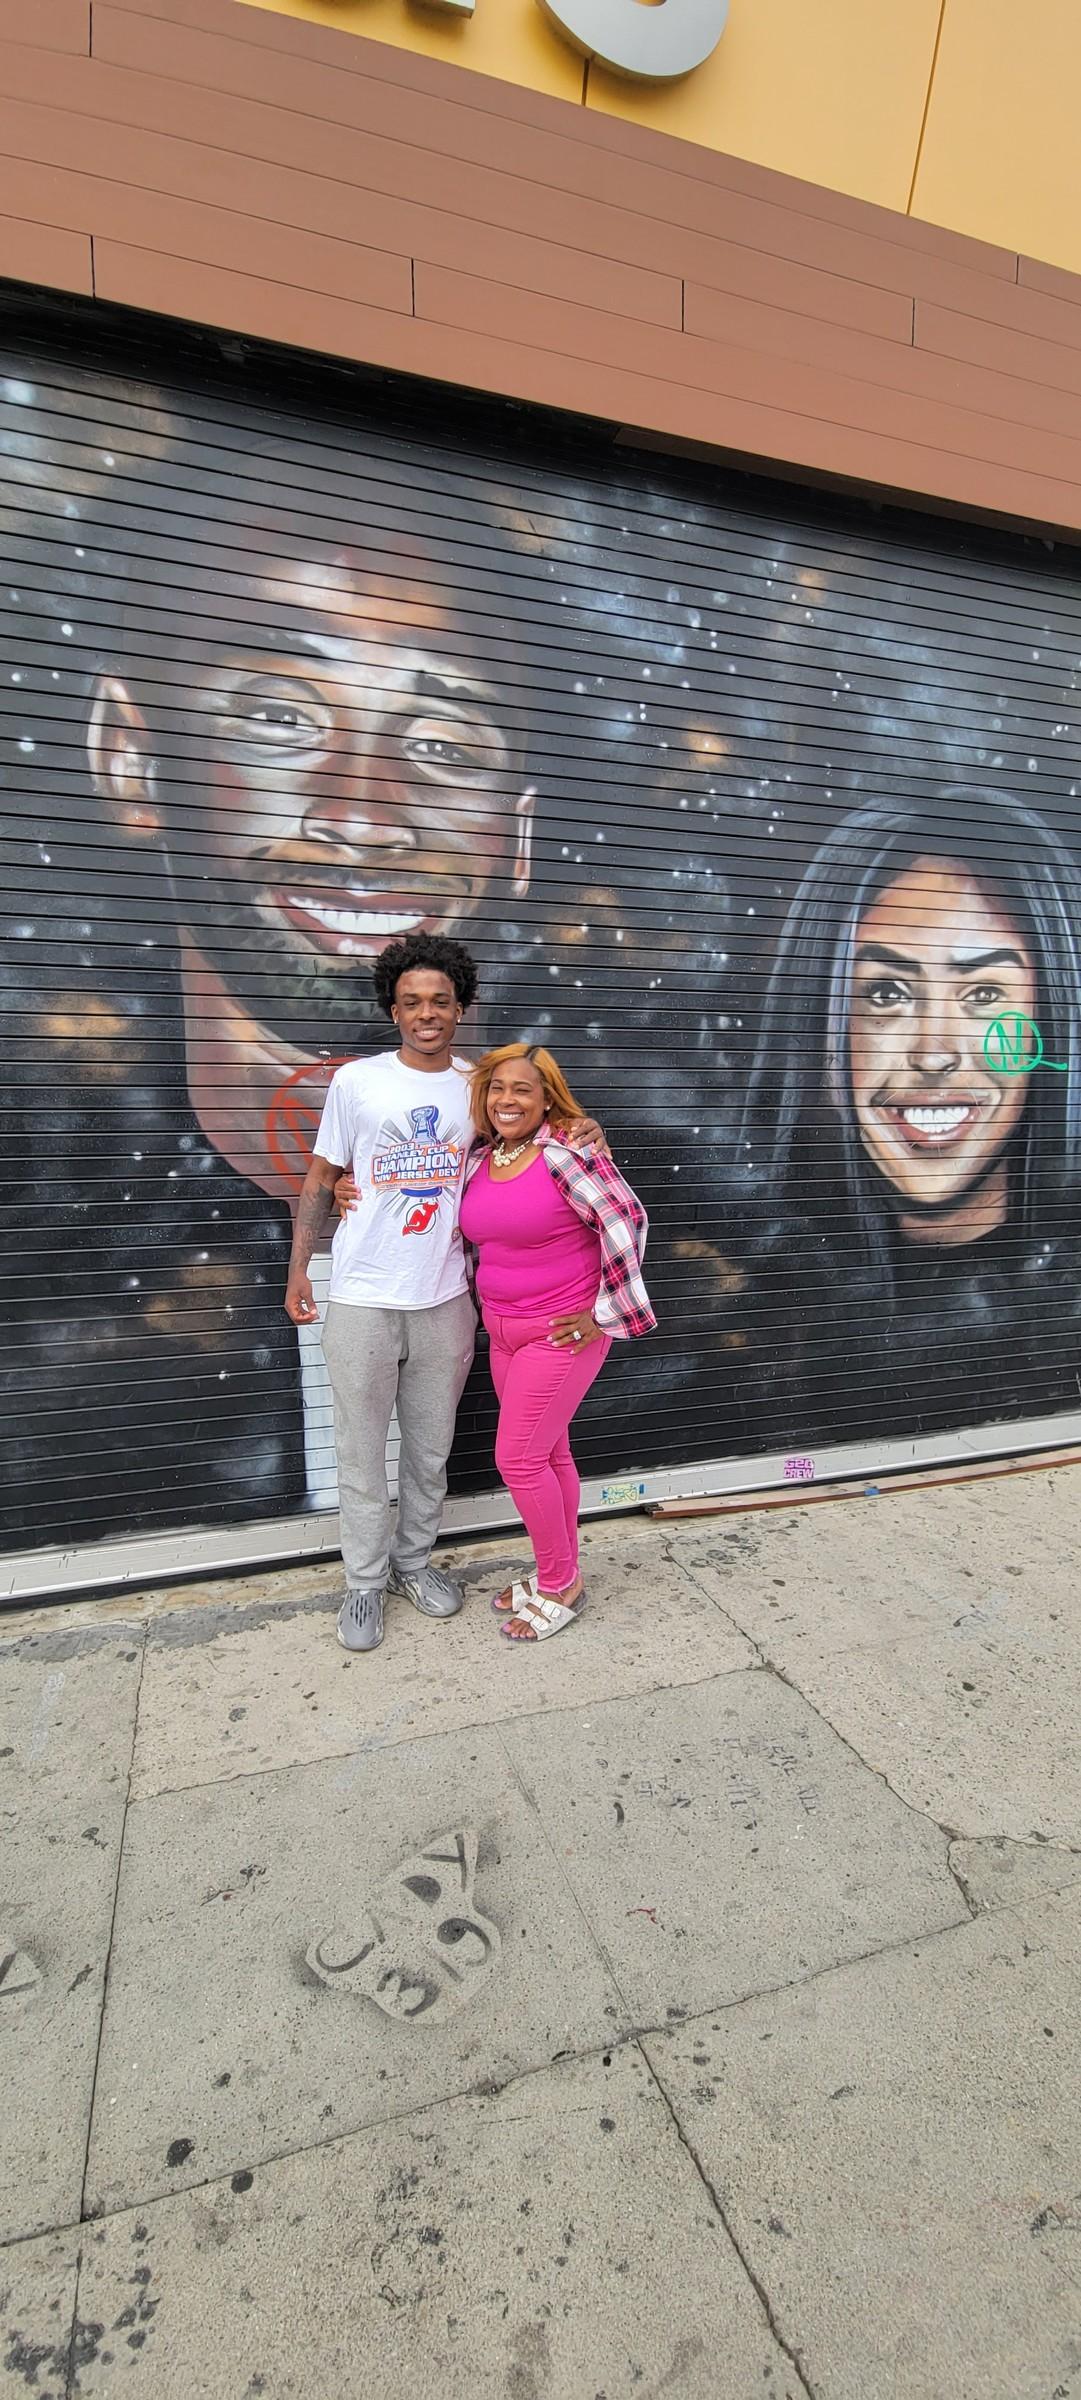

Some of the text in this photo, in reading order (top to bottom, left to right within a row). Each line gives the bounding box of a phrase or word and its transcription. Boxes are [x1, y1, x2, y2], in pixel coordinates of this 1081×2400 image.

[381, 1145, 450, 1162] STANLEY CUP
[390, 1142, 415, 1154] 2003
[395, 1168, 436, 1180] JERSEY
[438, 1167, 460, 1178] DEV
[783, 1468, 814, 1479] CREW
